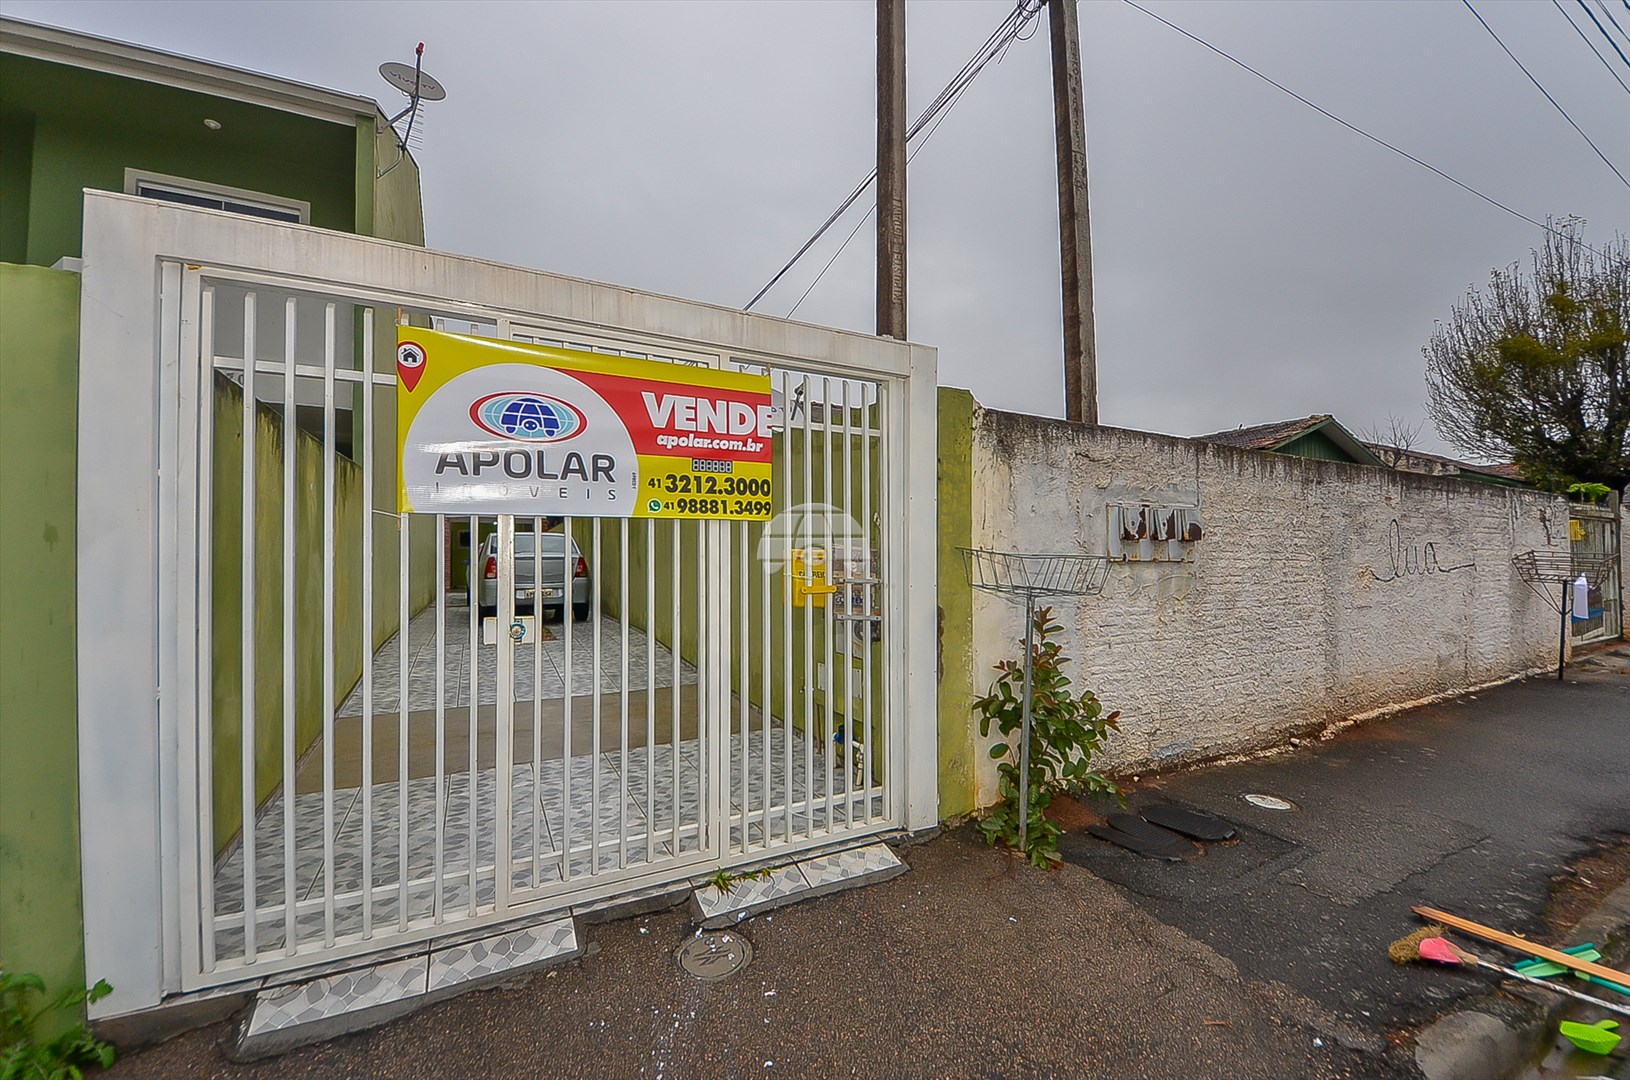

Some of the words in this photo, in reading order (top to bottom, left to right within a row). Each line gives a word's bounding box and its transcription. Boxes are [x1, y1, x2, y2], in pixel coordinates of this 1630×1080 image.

[640, 391, 772, 438] VENDE
[656, 433, 763, 452] apolar.com.br
[435, 449, 616, 483] APOLAR
[648, 478, 661, 488] 41
[665, 474, 771, 497] 3212.3000
[663, 501, 675, 510] 41
[677, 498, 772, 515] 98881.3499
